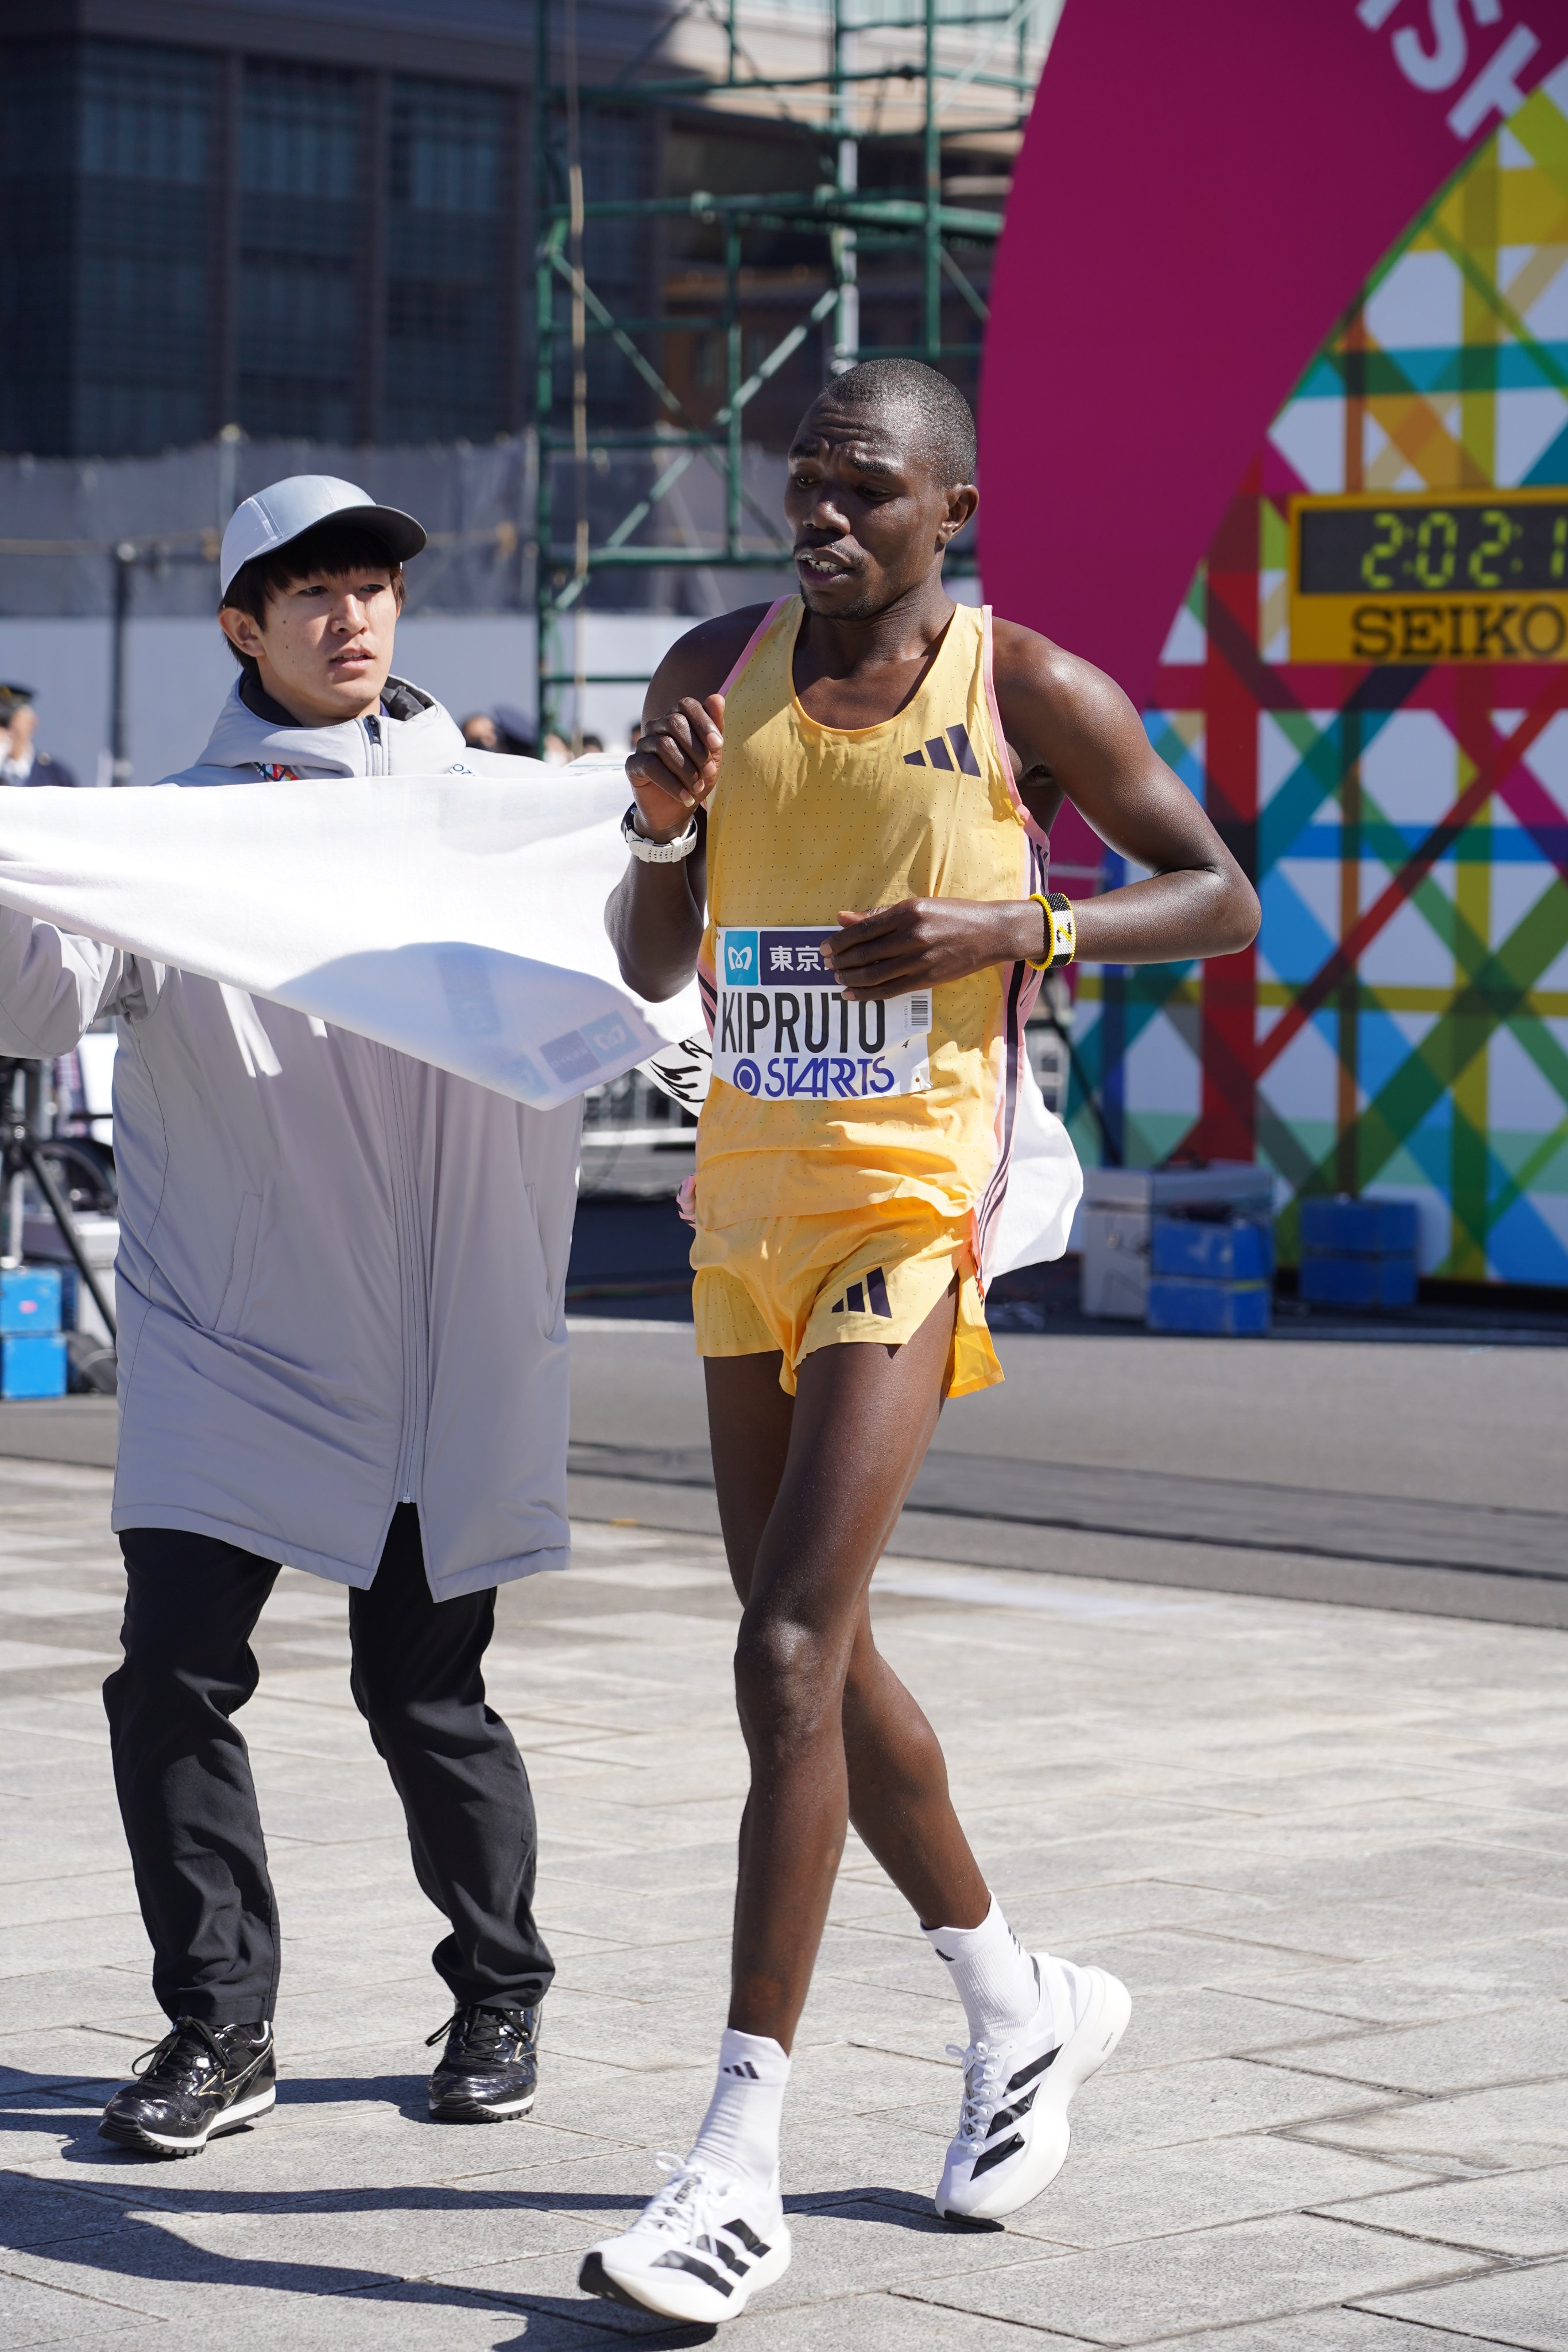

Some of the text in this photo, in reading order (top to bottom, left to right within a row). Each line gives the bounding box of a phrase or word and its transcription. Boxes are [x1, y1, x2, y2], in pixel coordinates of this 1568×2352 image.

[1351, 603, 1567, 657] SEIKO
[721, 992, 885, 1053] KIPRUTO
[902, 1039, 910, 1048] 4
